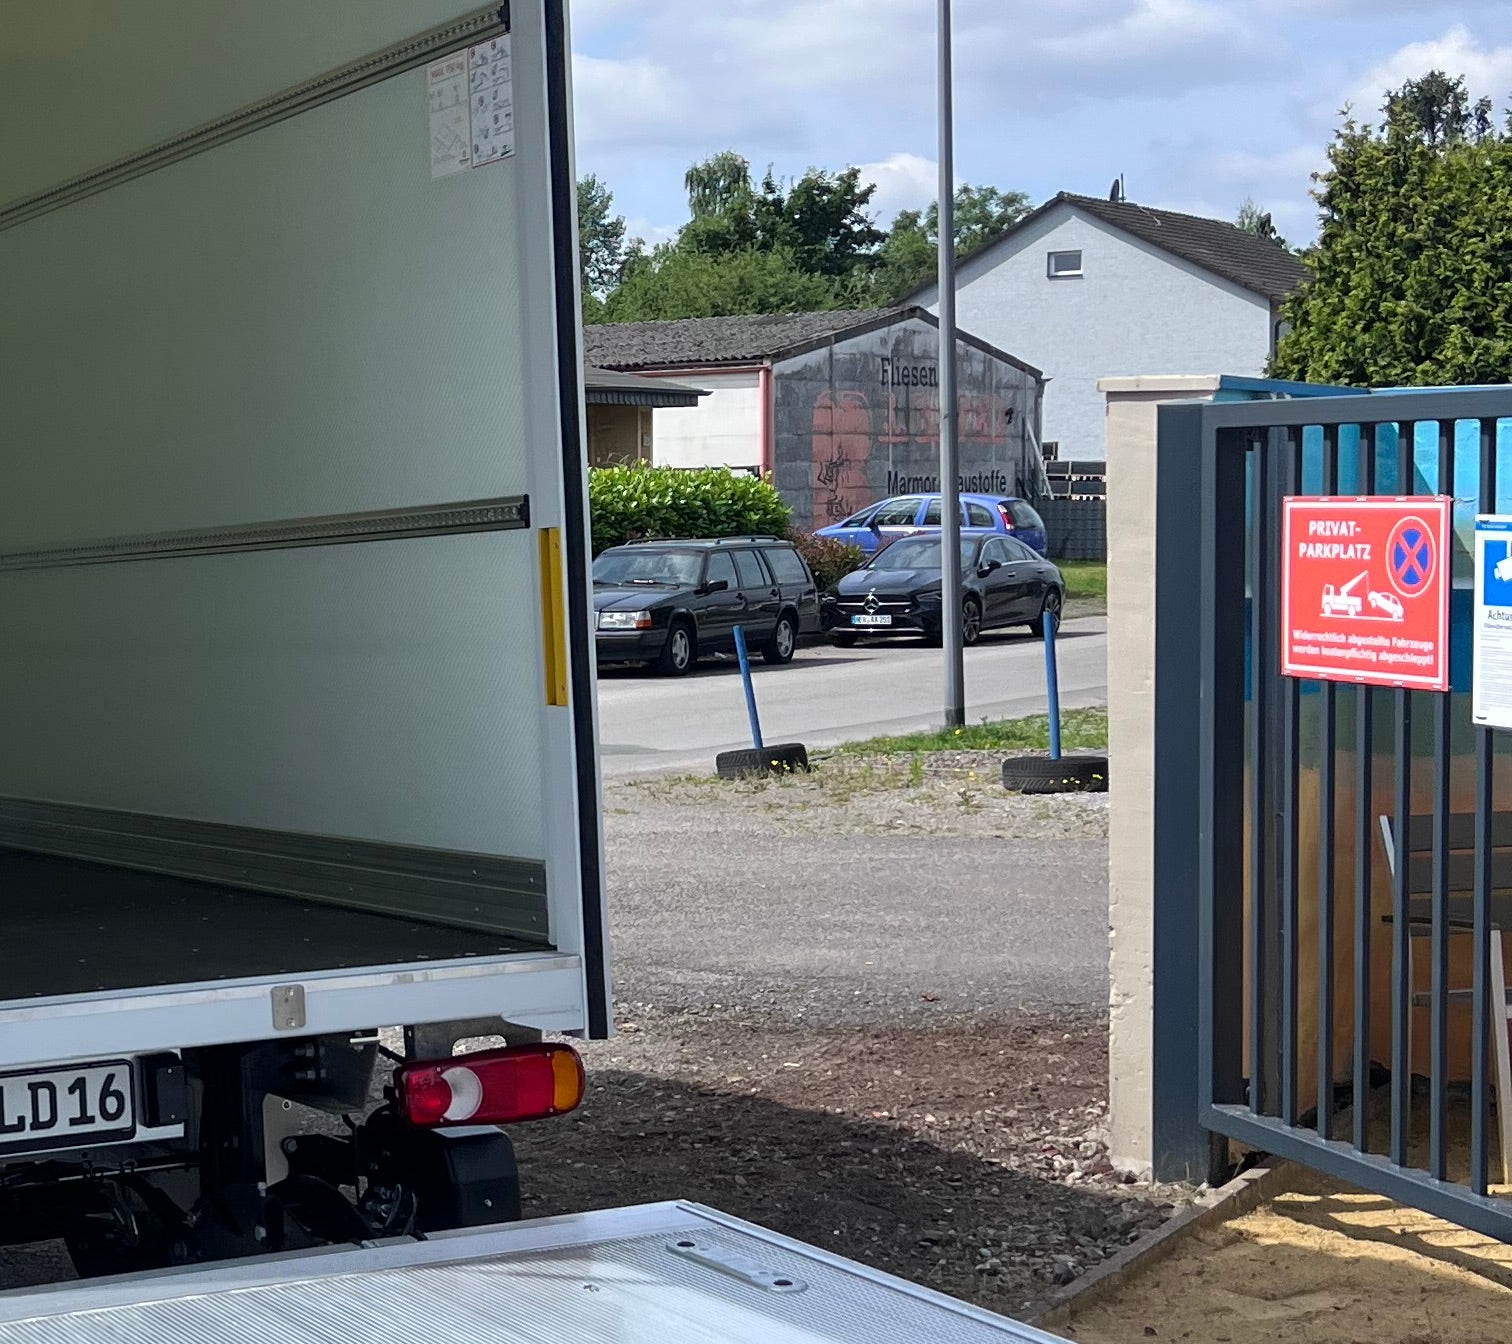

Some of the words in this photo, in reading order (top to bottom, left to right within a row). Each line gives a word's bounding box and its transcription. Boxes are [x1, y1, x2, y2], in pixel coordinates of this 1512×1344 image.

[880, 357, 937, 387] Fliesen
[887, 470, 937, 495] Marmor
[958, 469, 1007, 493] austoffe
[1308, 520, 1362, 537] PRIVAT-
[1298, 542, 1372, 560] PARKPLATZ
[1292, 644, 1320, 655] werden
[1391, 636, 1434, 652] Fahrzeuge
